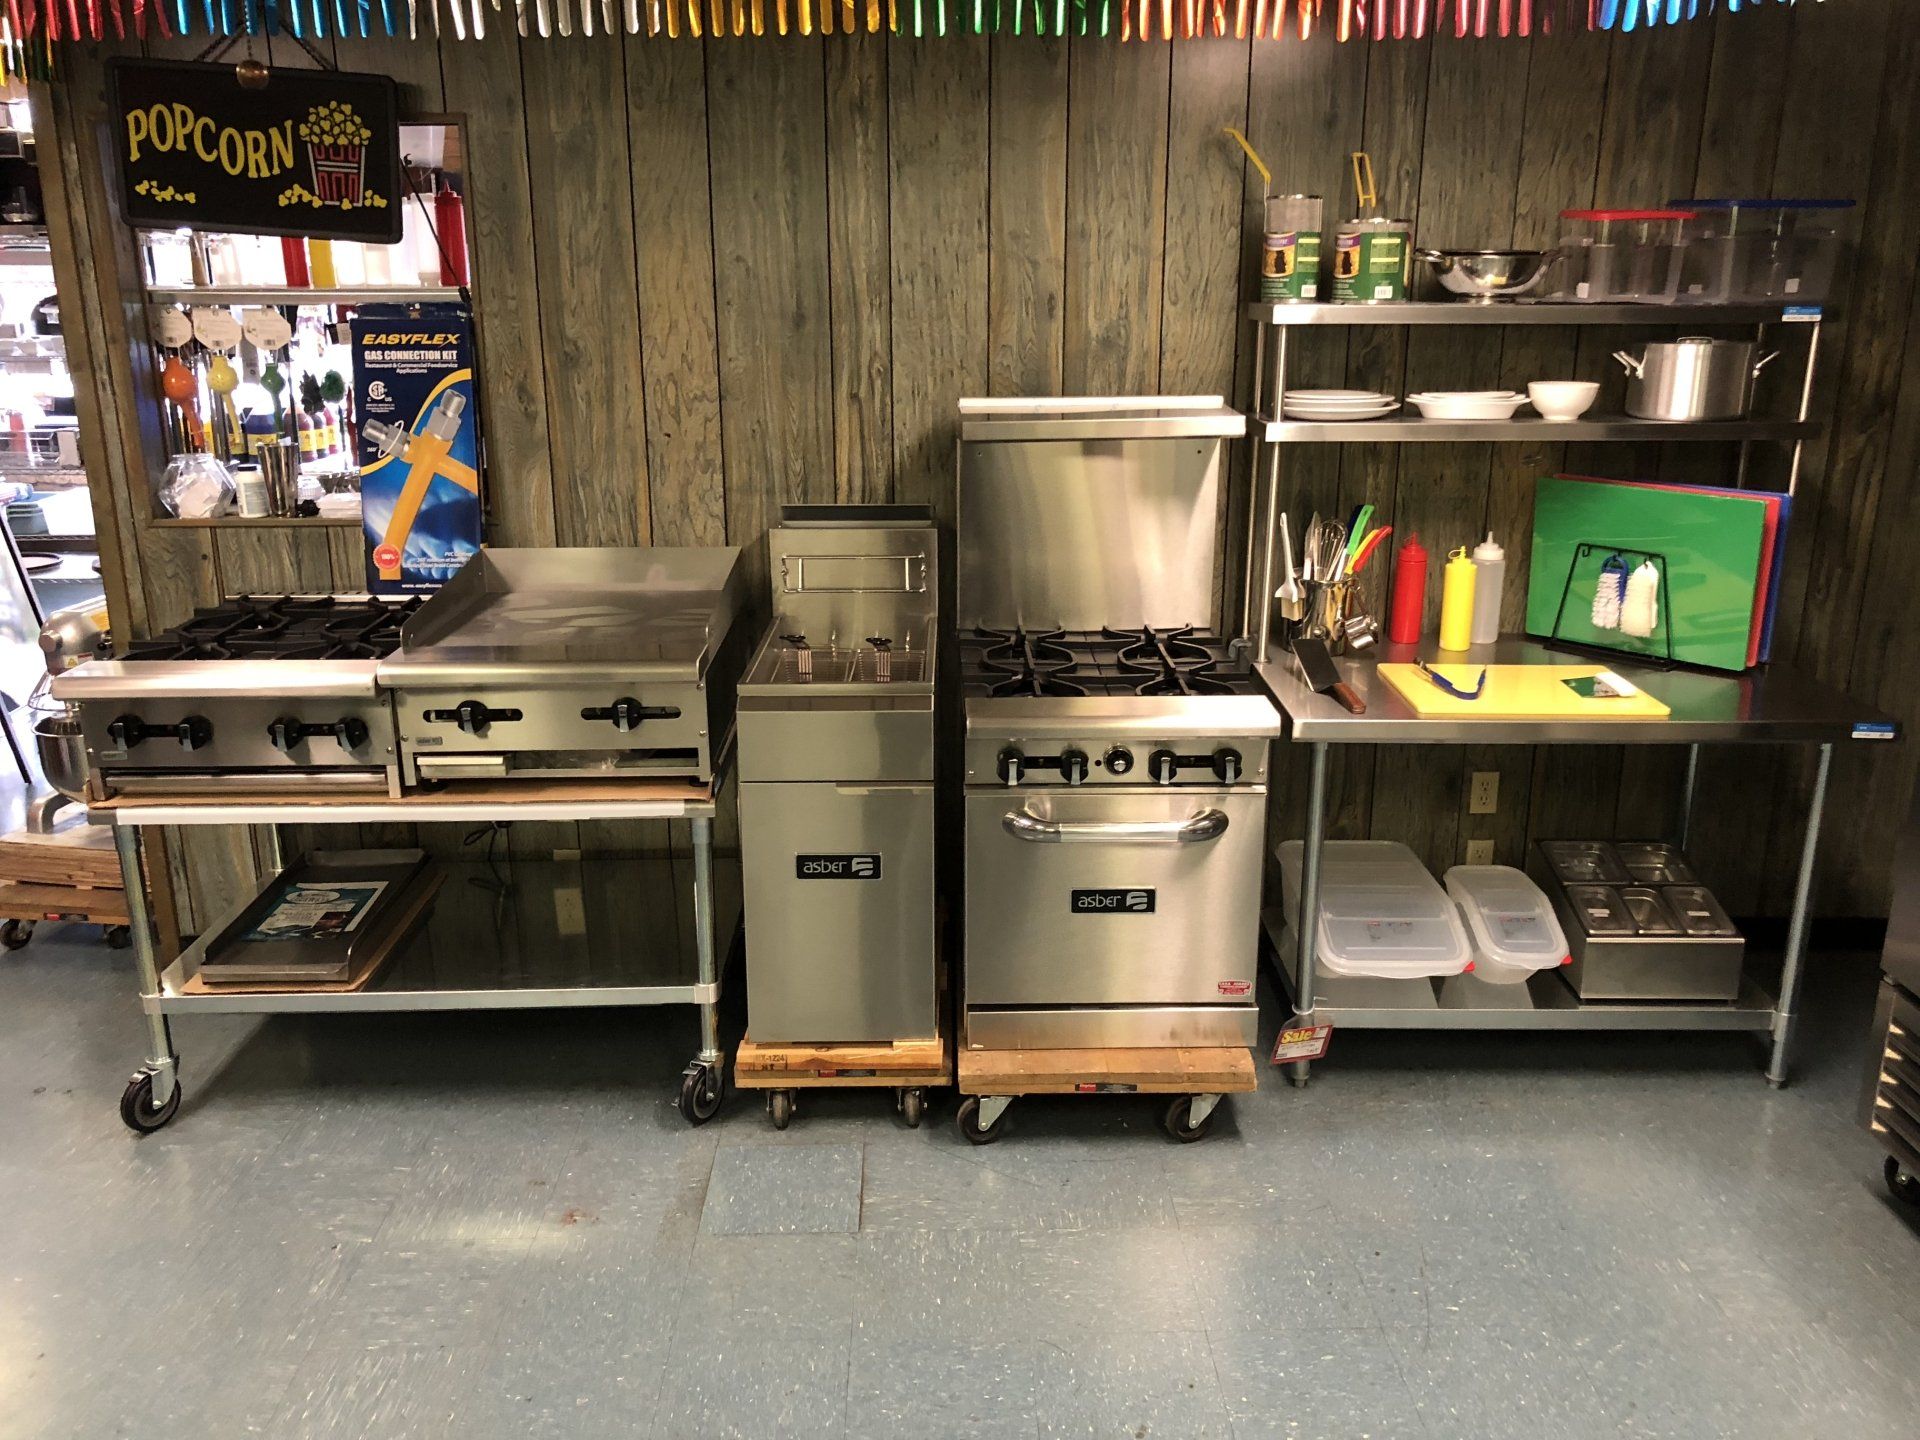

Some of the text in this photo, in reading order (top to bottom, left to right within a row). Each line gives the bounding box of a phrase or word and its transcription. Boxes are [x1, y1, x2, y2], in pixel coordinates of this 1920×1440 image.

[126, 102, 294, 178] POPCORN
[362, 333, 461, 346] EASYFLEX
[364, 350, 458, 361] GAS CONNECTION KIT
[803, 859, 848, 873] asber
[1078, 893, 1122, 908] asber
[1281, 1029, 1313, 1044] Sale
